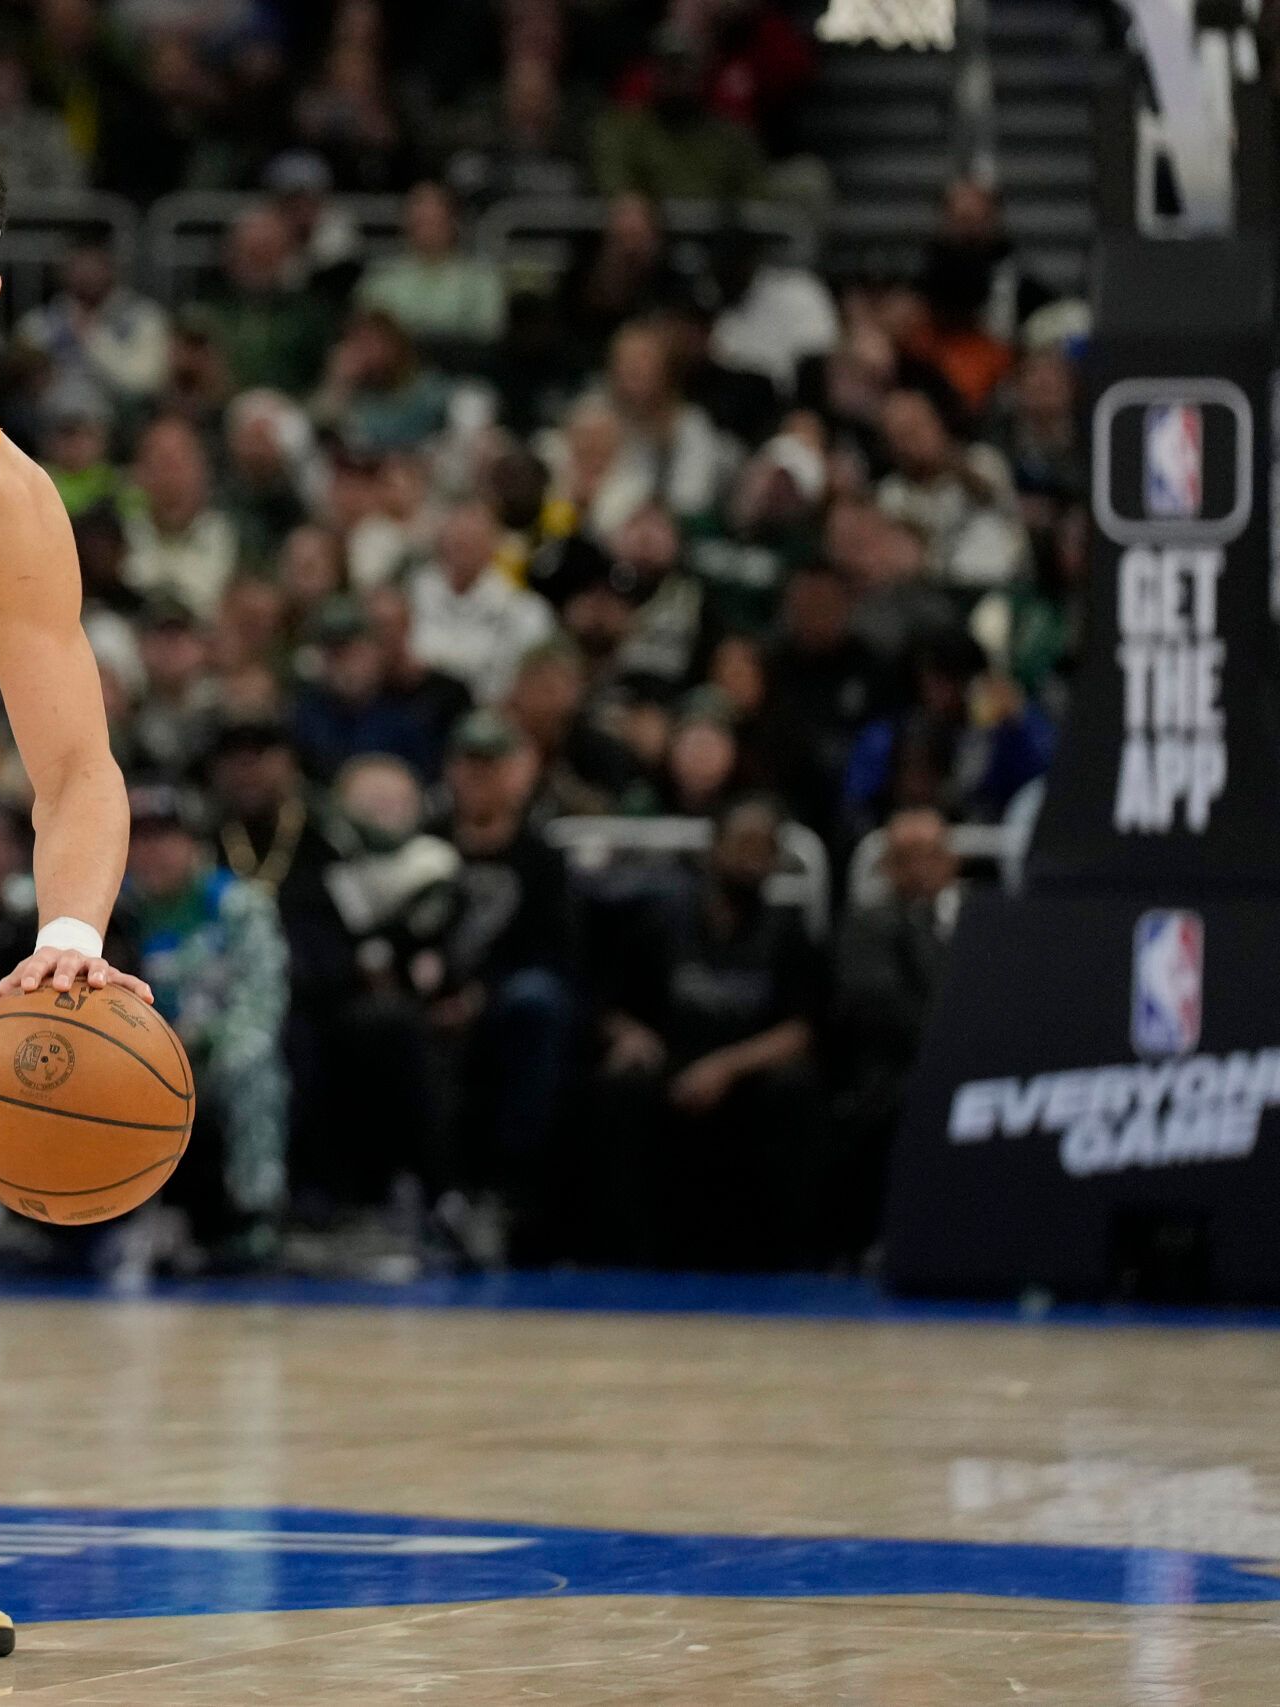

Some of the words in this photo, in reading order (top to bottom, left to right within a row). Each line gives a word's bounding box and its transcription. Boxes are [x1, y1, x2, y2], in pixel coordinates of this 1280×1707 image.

[1118, 547, 1225, 636] GET
[1117, 638, 1225, 733] THE
[1115, 736, 1227, 834] APP
[1060, 1096, 1261, 1175] GAME
